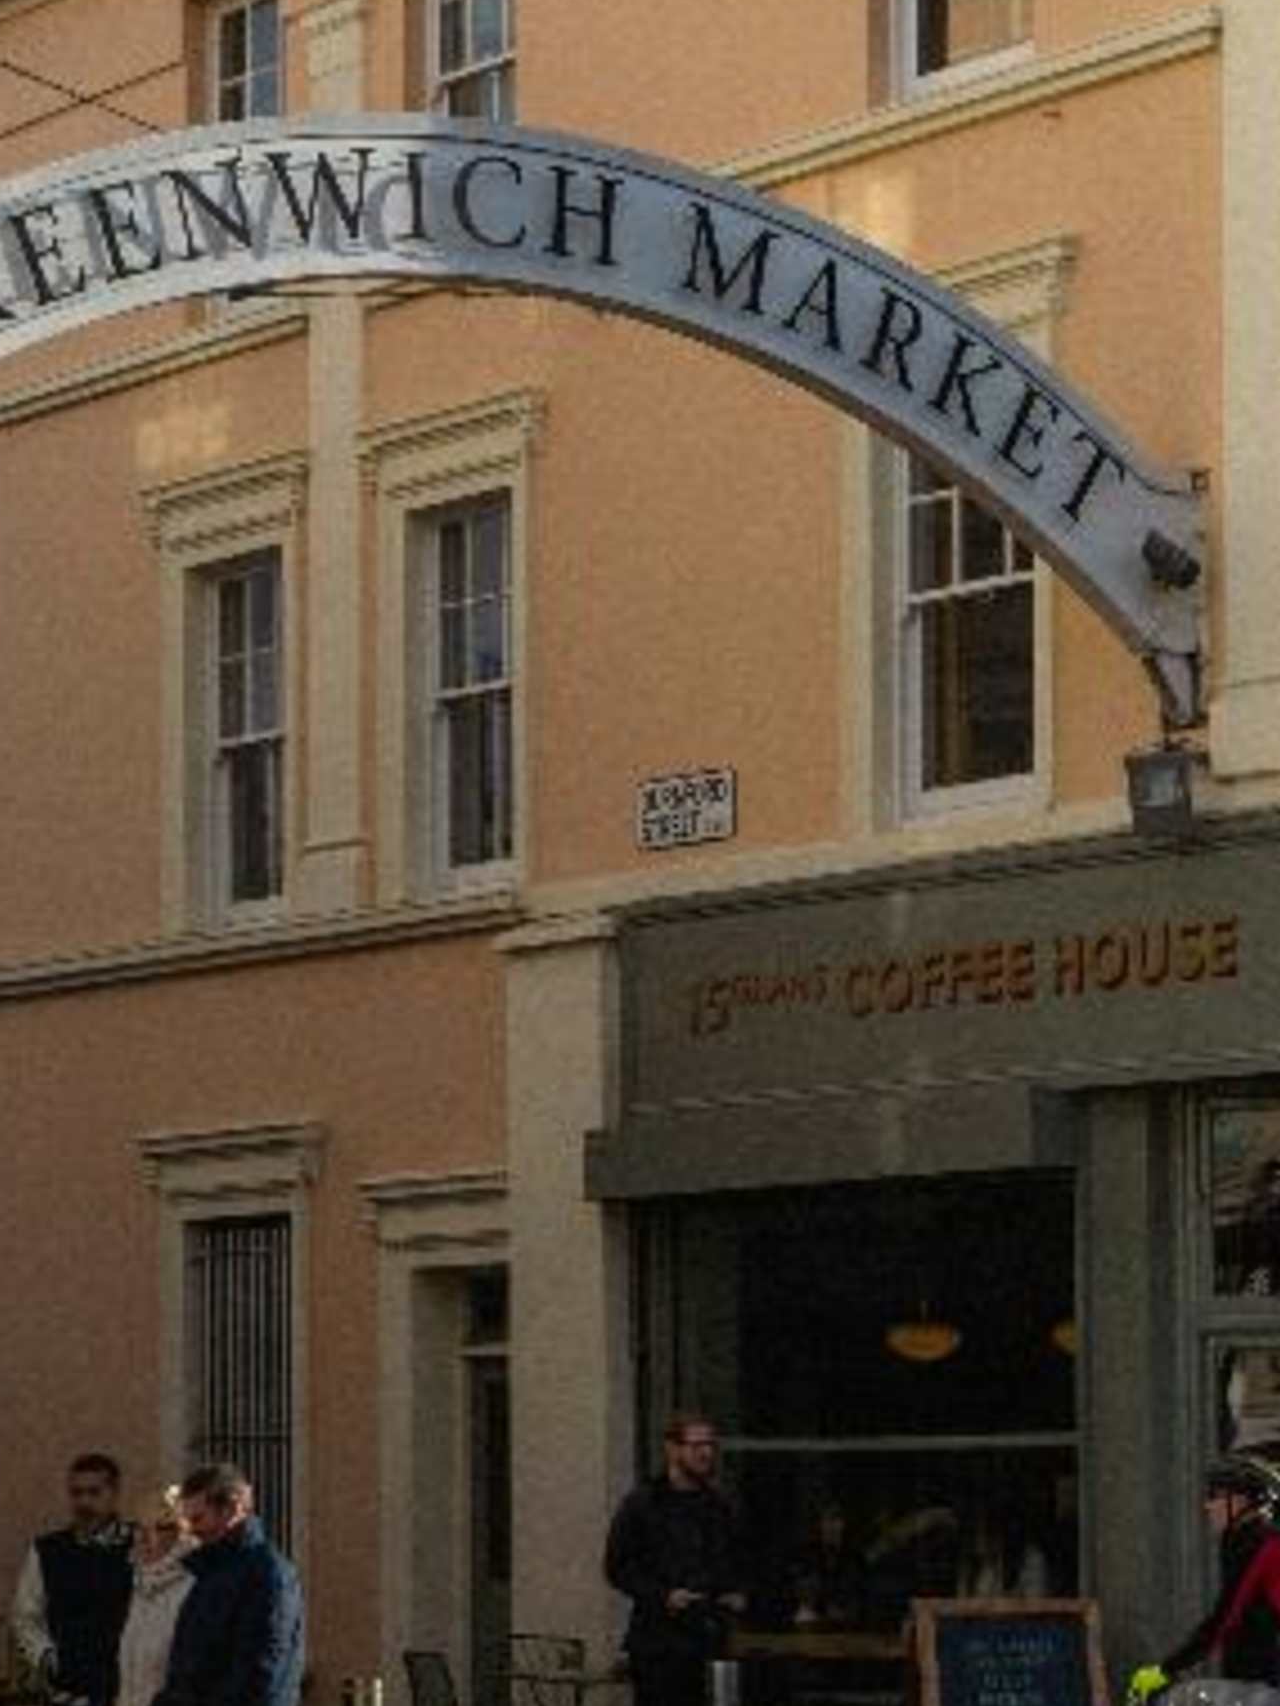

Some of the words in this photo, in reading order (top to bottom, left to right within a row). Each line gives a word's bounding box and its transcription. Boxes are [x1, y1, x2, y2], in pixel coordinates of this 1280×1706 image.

[680, 200, 1125, 523] MARKET
[843, 938, 1037, 1020] COFFEE
[1053, 914, 1240, 998] HOUSE
